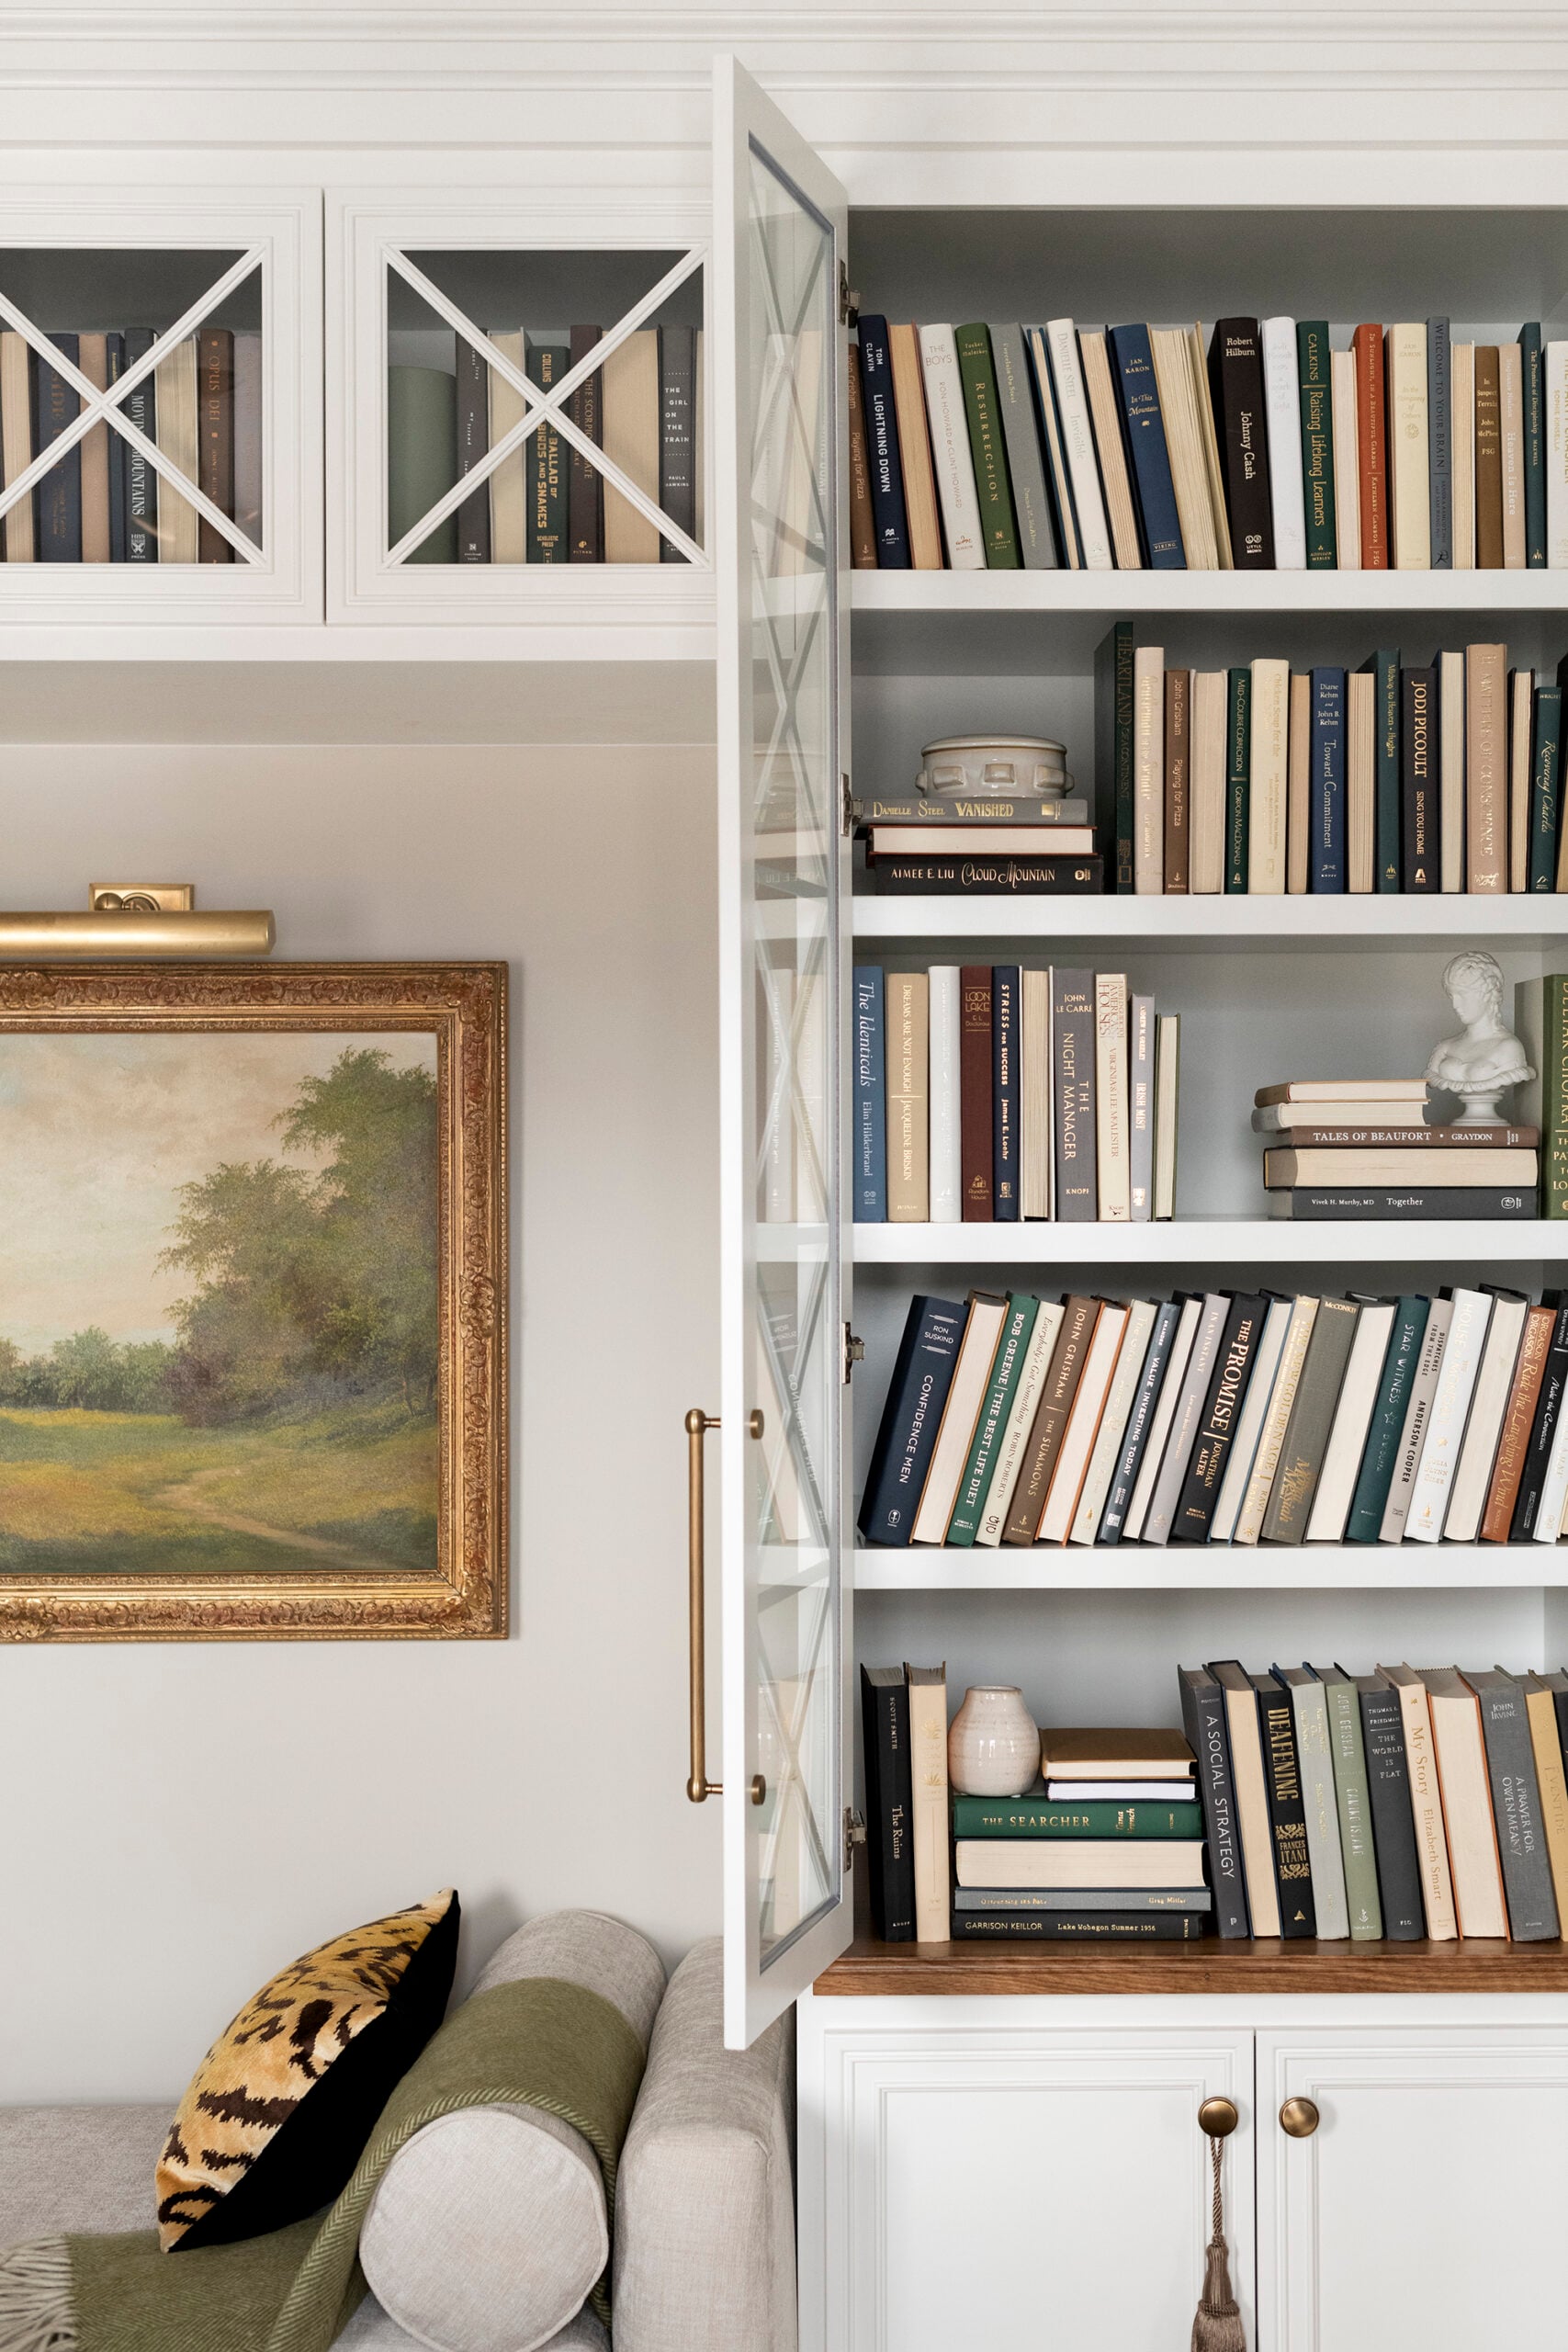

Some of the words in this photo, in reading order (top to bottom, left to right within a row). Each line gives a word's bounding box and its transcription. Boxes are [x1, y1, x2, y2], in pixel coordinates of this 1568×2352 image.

[866, 343, 875, 372] CLAVIN
[925, 355, 953, 366] BOYS
[1225, 348, 1255, 356] Hilburn
[1307, 333, 1319, 380] CALKINS
[1435, 324, 1444, 377] WELCOME
[209, 356, 220, 390] OPUS
[542, 354, 551, 383] COLLINS
[1125, 366, 1150, 374] KARON
[1436, 382, 1444, 397] TO
[209, 400, 220, 421] DEI
[874, 394, 888, 456] LIGHTNING
[1307, 391, 1324, 431] Raising
[1435, 398, 1445, 429] YOUR
[1240, 412, 1253, 450] Johnny
[1308, 435, 1326, 477] Lifelong
[1436, 434, 1446, 468] BRAIN
[1506, 432, 1517, 472] Heaven
[879, 459, 891, 492] DOWN
[1244, 452, 1257, 480] Cash
[1508, 477, 1516, 487] is
[1314, 481, 1327, 526] Learners
[1508, 490, 1517, 516] Here
[1118, 636, 1132, 726] HEARTLAND
[1174, 679, 1183, 700] John
[1387, 691, 1395, 700] to
[1411, 681, 1427, 715] JODI
[1174, 702, 1183, 735] Grisham
[1387, 700, 1396, 726] Heaven
[1324, 739, 1337, 777] Toward
[1414, 717, 1427, 778] PICOULT
[1172, 759, 1183, 788] Playing
[1536, 741, 1556, 793] Recovering
[1174, 790, 1183, 803] for
[1481, 764, 1493, 856] CONSCIENCE
[1174, 805, 1183, 827] Pizza
[1324, 781, 1337, 849] Commitment
[1541, 795, 1555, 834] Charles
[859, 981, 874, 1011] The
[902, 985, 913, 1018] DREAMS
[964, 992, 990, 1001] LOON
[964, 1002, 990, 1012] LAKE
[1064, 994, 1086, 1002] JOHN
[903, 1018, 912, 1036] ARE
[860, 1014, 876, 1088] Identicals
[904, 1038, 912, 1056] NOT
[1063, 1033, 1076, 1079] NIGHT
[903, 1057, 913, 1091] ENOUGH
[1078, 1080, 1089, 1113] THE
[1136, 1082, 1146, 1106] IRISH
[863, 1101, 872, 1120] Elin
[1064, 1086, 1077, 1161] MANAGER
[1135, 1108, 1146, 1132] MIST
[863, 1123, 873, 1176] Hilderbrand
[1313, 1132, 1348, 1142] TALES
[1352, 1132, 1367, 1141] OF
[1371, 1132, 1432, 1142] BEAUFORT
[1451, 1133, 1493, 1141] GRAYDON
[1386, 1197, 1424, 1207] Together
[933, 1325, 949, 1334] RON
[1011, 1312, 1025, 1336] BOB
[1071, 1306, 1088, 1340] JOHN
[1158, 1319, 1168, 1346] BRANDES
[1238, 1319, 1253, 1342] THE
[1400, 1323, 1415, 1351] STAR
[1428, 1323, 1438, 1343] FROM
[924, 1332, 953, 1344] SUSKIND
[1431, 1332, 1446, 1373] DISPATCHES
[998, 1339, 1018, 1385] GREENE
[1055, 1345, 1077, 1398] GRISHAM
[1146, 1357, 1161, 1387] VALUE
[1521, 1362, 1538, 1391] Ride
[1211, 1341, 1249, 1431] PROMISE
[1389, 1358, 1407, 1404] WITNESS
[906, 1374, 933, 1453] CONFIDENCE
[990, 1392, 1005, 1417] THE
[1516, 1393, 1531, 1410] the
[1046, 1419, 1055, 1433] THE
[1132, 1391, 1151, 1442] INVESTING
[1409, 1400, 1427, 1446] ANDERSON
[981, 1419, 997, 1449] BEST
[1009, 1431, 1021, 1460] ROBIN
[1499, 1409, 1527, 1467] Laughing
[899, 1456, 914, 1485] MEN
[974, 1450, 988, 1476] LIFE
[1028, 1437, 1052, 1498] SUMMONS
[1122, 1446, 1137, 1476] TODAY
[1195, 1448, 1210, 1477] ALTER
[1204, 1441, 1223, 1488] JONATHAN
[1402, 1448, 1416, 1483] COOPER
[966, 1478, 981, 1507] DIET
[998, 1461, 1014, 1499] ROBERTS
[1495, 1470, 1516, 1509] Wind
[1206, 1715, 1218, 1727] A
[1370, 1716, 1400, 1725] FRIEDMAN
[1491, 1711, 1517, 1721] IRVING
[1492, 1702, 1514, 1713] JOHN
[1372, 1746, 1404, 1755] WORLD
[1378, 1734, 1396, 1742] THE
[1411, 1725, 1425, 1750] My
[1207, 1731, 1225, 1791] SOCIAL
[1268, 1707, 1299, 1801] DEAFENING
[1380, 1770, 1402, 1779] FLAT
[1416, 1755, 1428, 1795] Story
[1516, 1777, 1526, 1786] A
[1502, 1777, 1516, 1813] OWEN
[1516, 1787, 1531, 1828] PRAYER
[1544, 1767, 1565, 1835] EVENTIDE
[891, 1804, 904, 1826] The
[983, 1817, 1003, 1826] THE
[1010, 1816, 1090, 1827] SEARCHER
[893, 1827, 904, 1860] Ruins
[1214, 1797, 1235, 1879] STRATEGY
[1280, 1839, 1306, 1850] FRANCES
[1507, 1814, 1523, 1857] MEANY
[1523, 1830, 1535, 1854] FOR
[1280, 1849, 1306, 1863] ITANI
[964, 1921, 1009, 1930] GARRISON
[1010, 1922, 1043, 1930] KEILLOR
